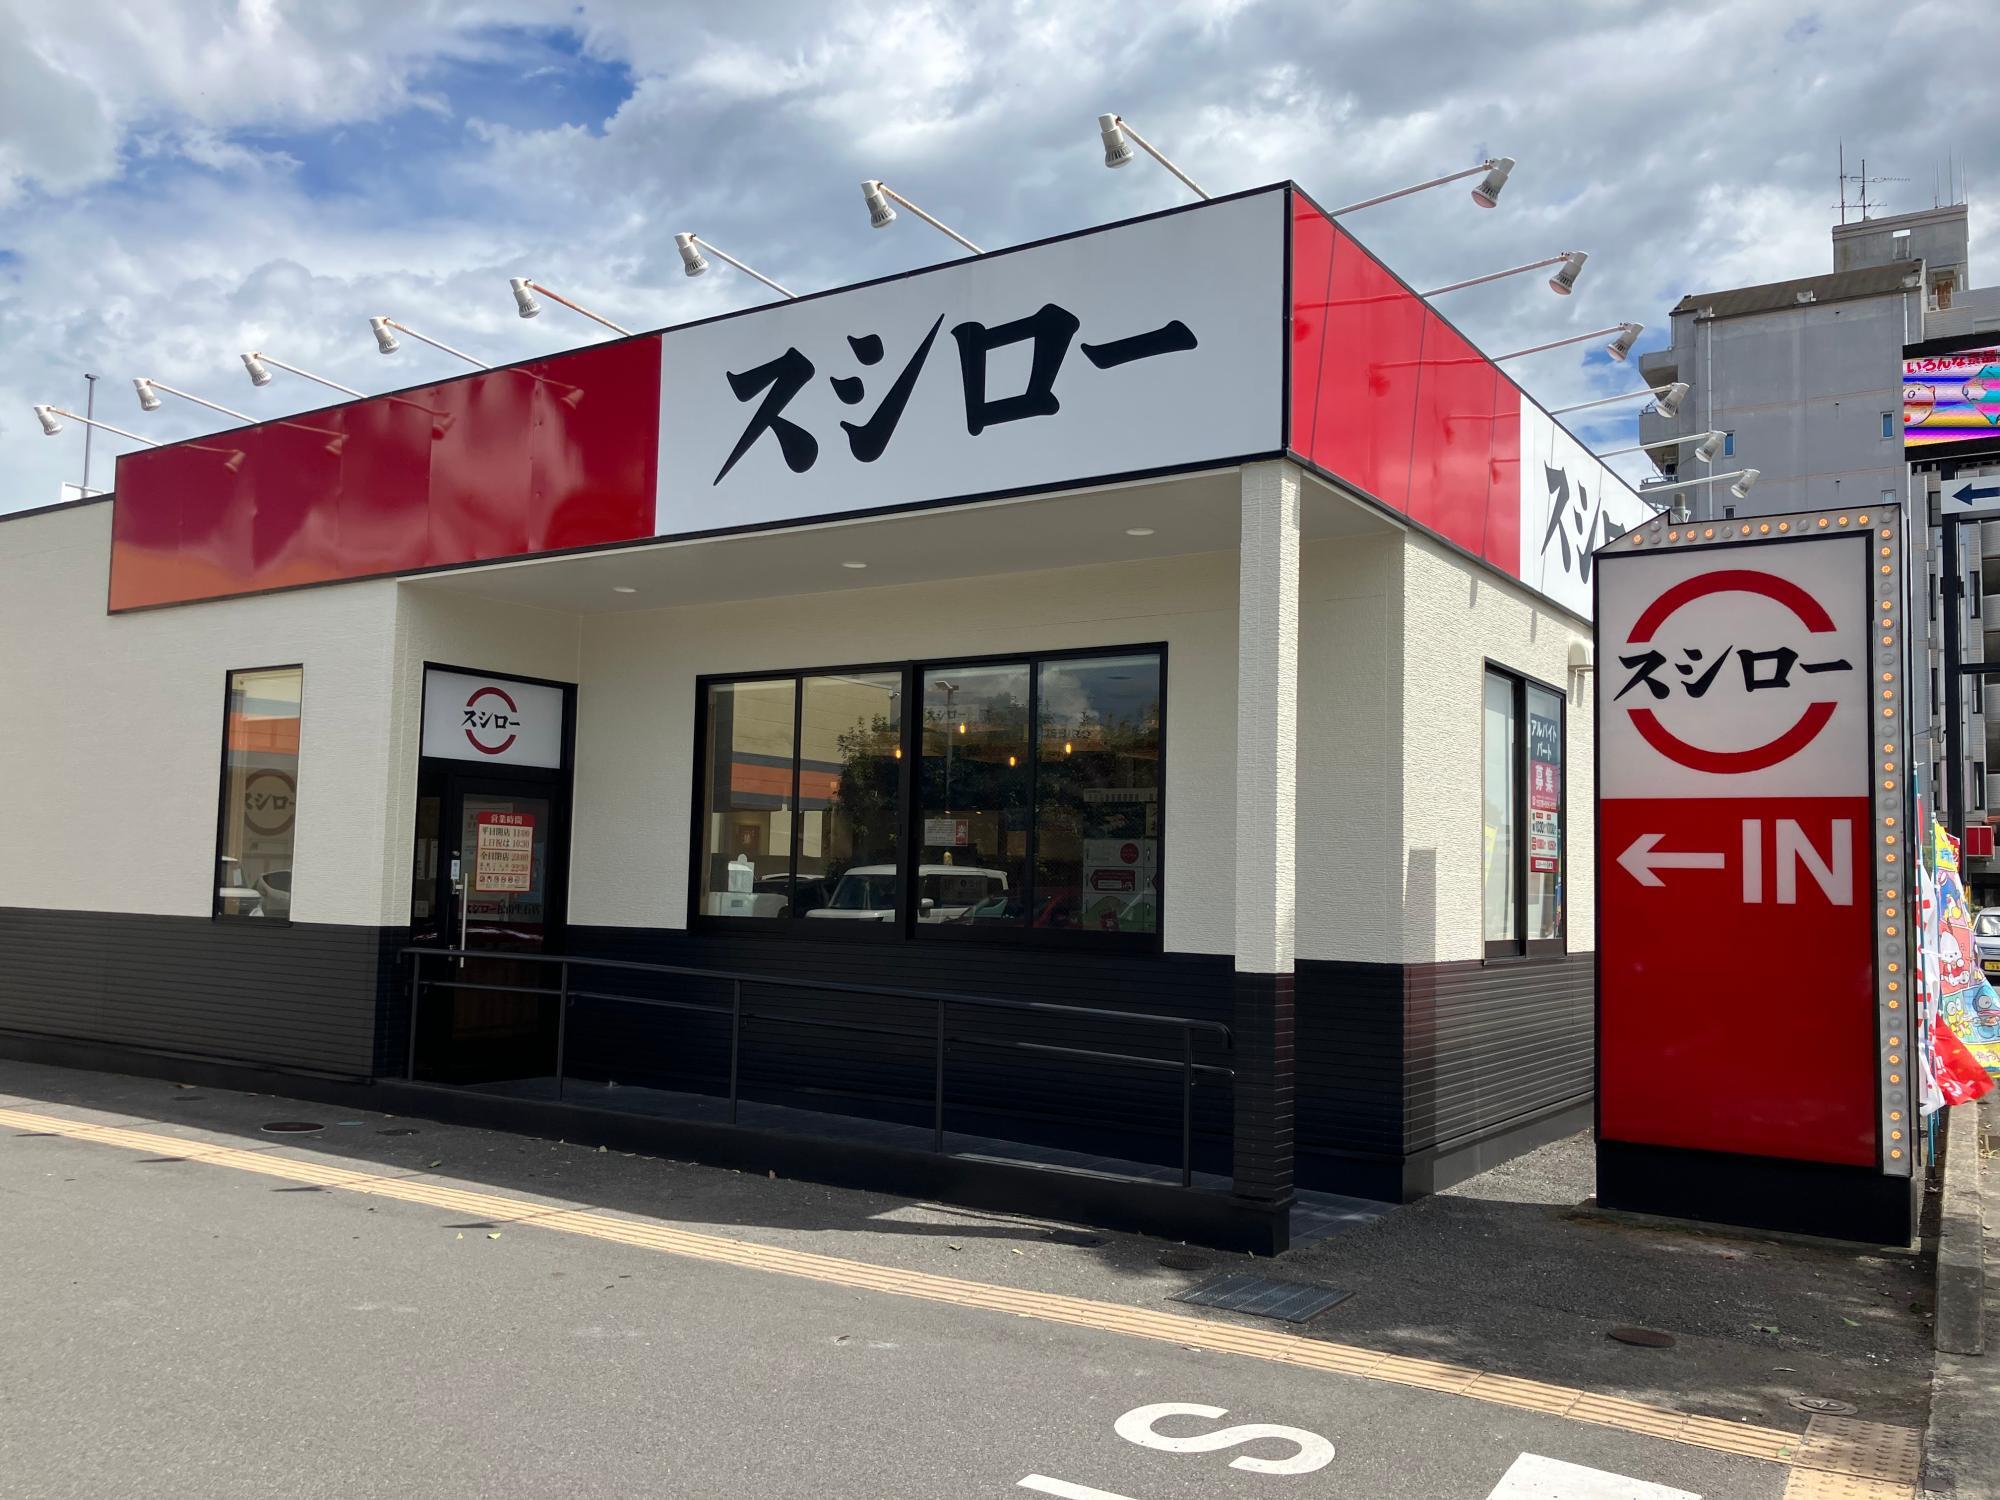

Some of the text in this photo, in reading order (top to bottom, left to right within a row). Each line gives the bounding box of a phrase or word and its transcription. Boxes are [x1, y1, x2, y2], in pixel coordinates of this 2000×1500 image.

[713, 303, 1198, 487] スシロー
[1613, 645, 1853, 702] スシロー
[461, 709, 520, 730] スシロー
[1531, 719, 1557, 743] アルバイト
[1535, 764, 1554, 793] 募集
[490, 814, 523, 825] 営業時間
[1742, 818, 1853, 906] IN
